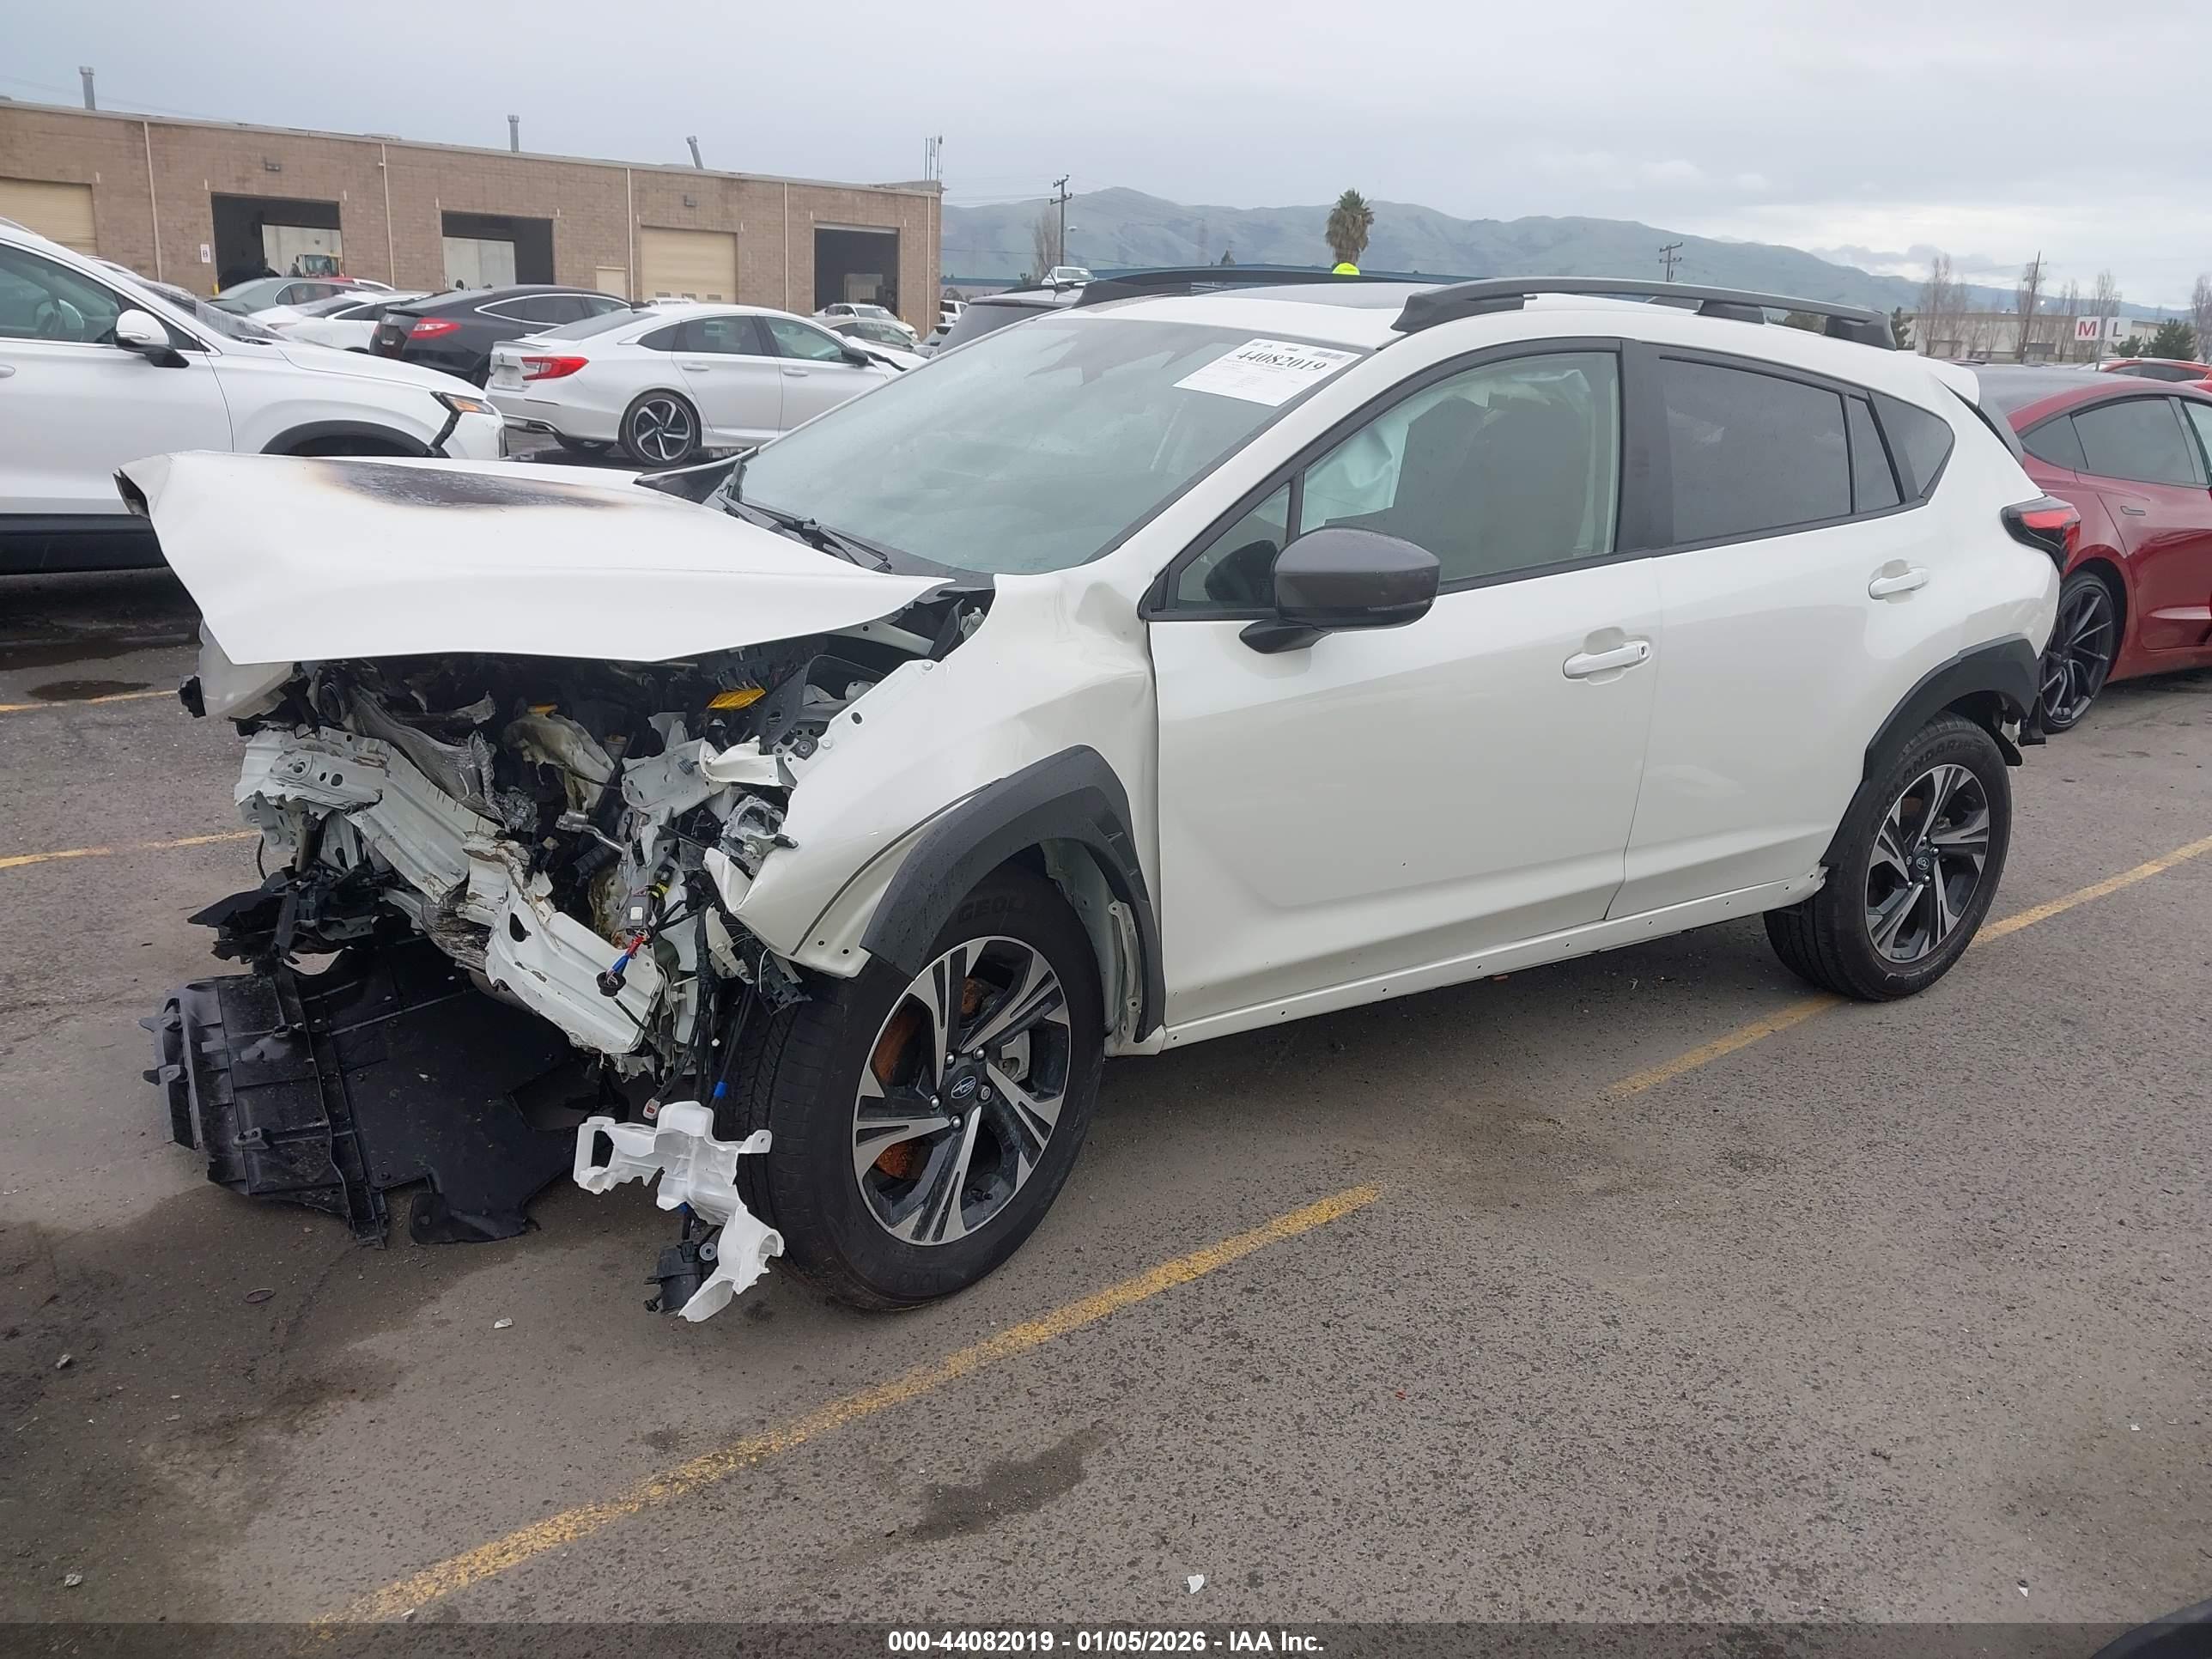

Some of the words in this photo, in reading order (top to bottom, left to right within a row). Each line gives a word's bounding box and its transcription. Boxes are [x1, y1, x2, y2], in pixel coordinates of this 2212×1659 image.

[2078, 321, 2097, 337] M
[2112, 321, 2123, 337] L
[1237, 350, 1328, 372] 44082019
